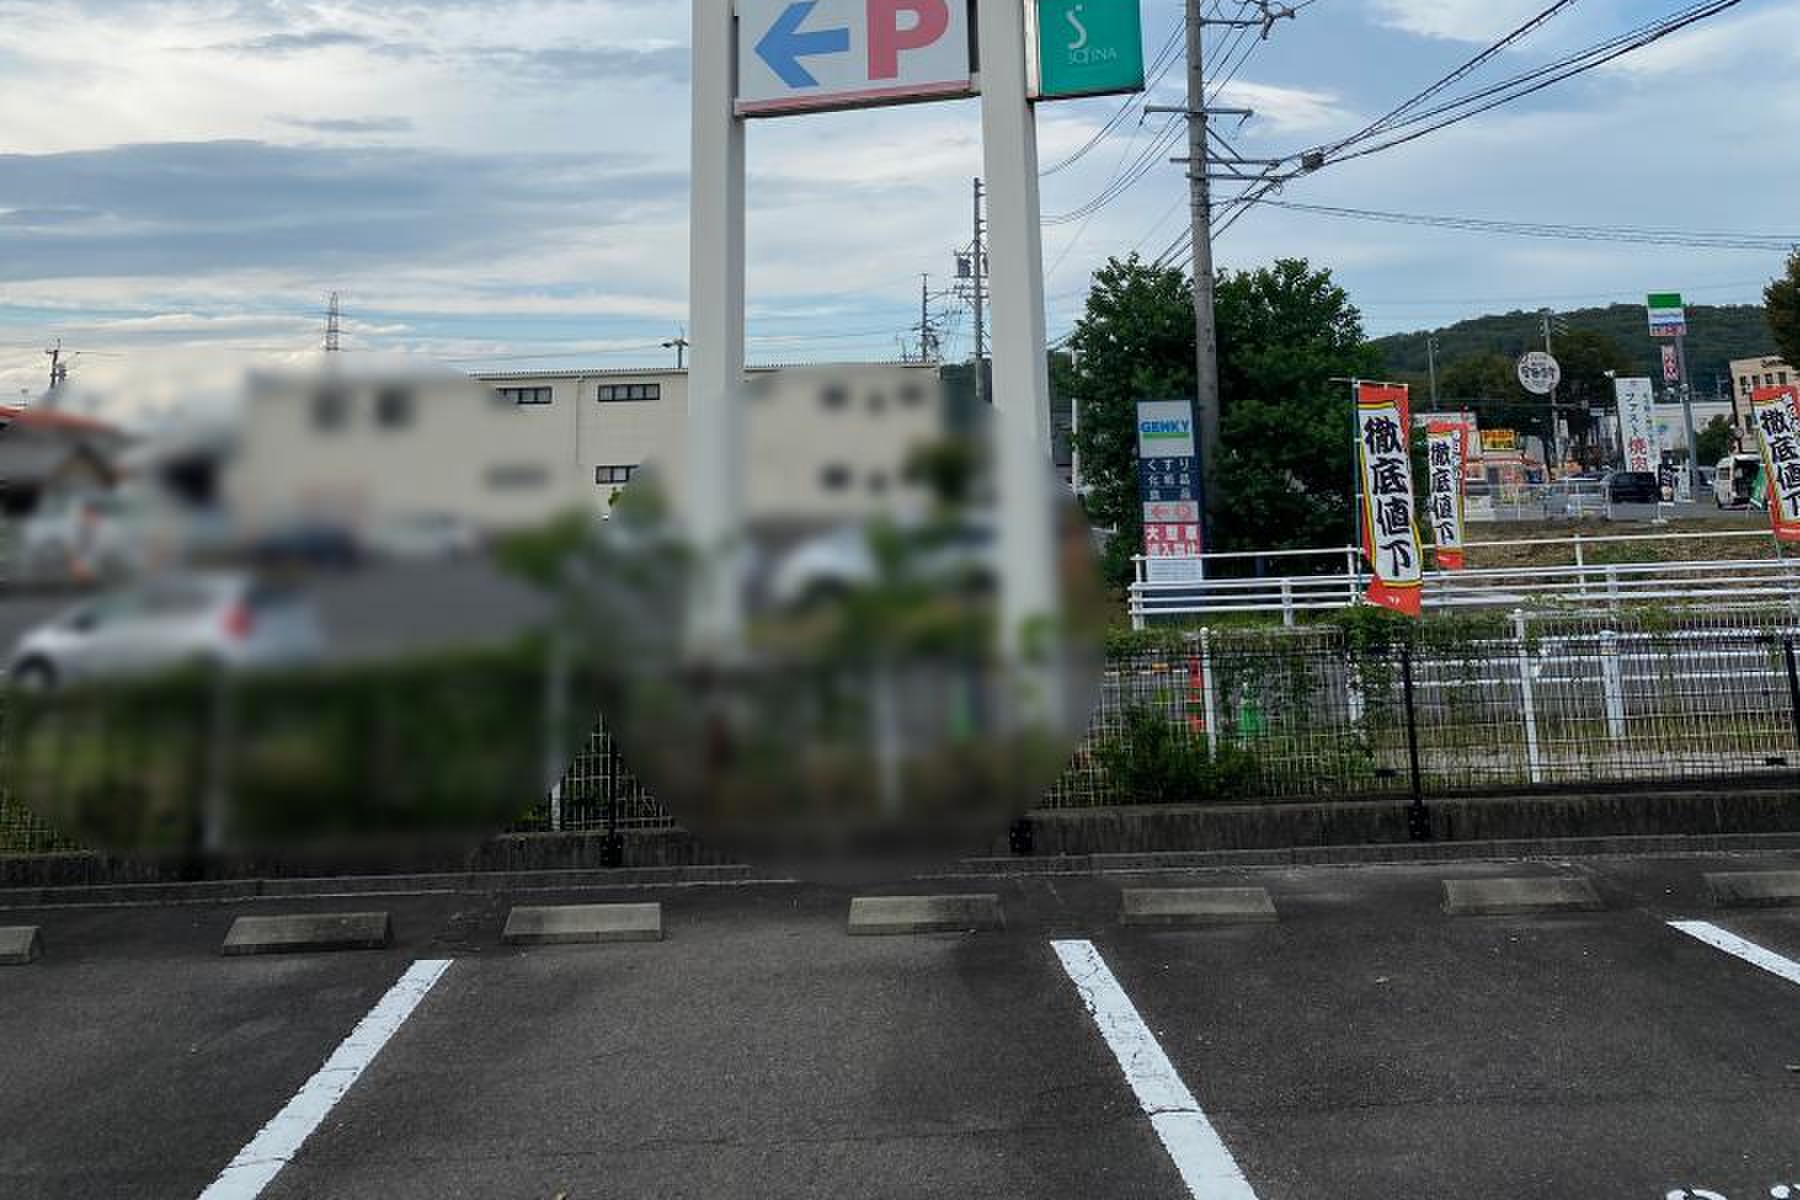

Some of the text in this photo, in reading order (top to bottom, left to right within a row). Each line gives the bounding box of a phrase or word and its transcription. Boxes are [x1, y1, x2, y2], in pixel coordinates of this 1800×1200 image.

[1141, 419, 1189, 432] GENKY
[1147, 458, 1189, 471] くすり
